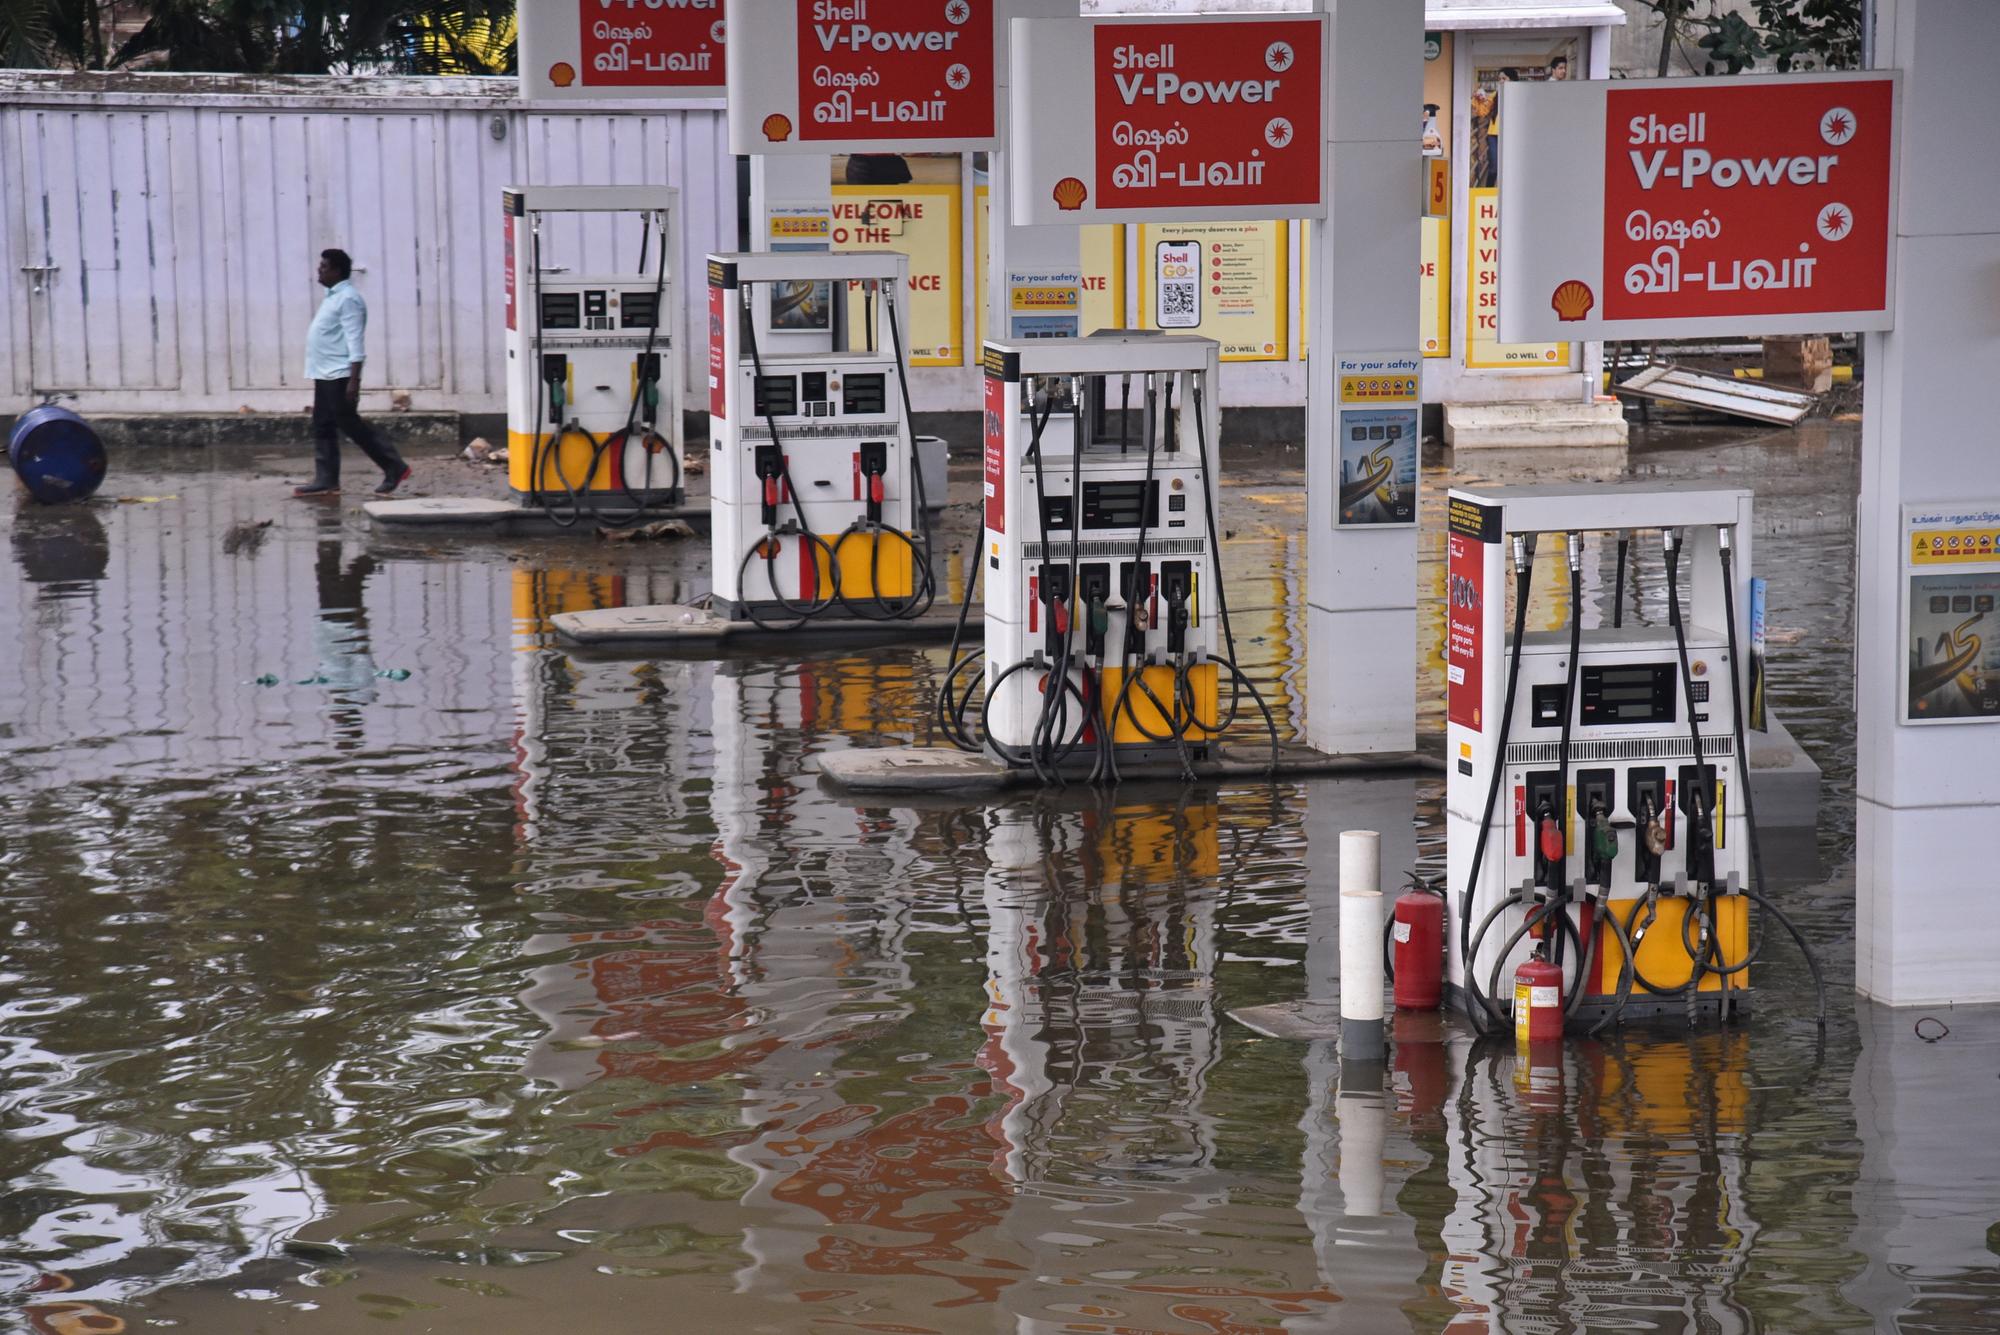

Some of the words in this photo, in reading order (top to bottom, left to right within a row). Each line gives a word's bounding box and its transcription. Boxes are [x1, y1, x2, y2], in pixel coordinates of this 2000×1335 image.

[813, 0, 866, 21] Shell
[593, 20, 653, 45] ஷெல்
[814, 24, 960, 52] V-Power
[593, 43, 712, 72] வி-பவர்
[1112, 44, 1174, 69] Shell
[812, 65, 880, 91] ஷெல்
[1113, 73, 1281, 105] V-Power
[812, 90, 947, 123] வி-பவர்
[1112, 121, 1189, 152] ஷெல்
[1628, 112, 1706, 145] Shell
[1112, 149, 1266, 189] வி-பவர்
[1629, 148, 1839, 190] V-Power
[1434, 171, 1444, 203] 5
[854, 227, 891, 243] THE
[1162, 227, 1180, 235] Every
[1181, 226, 1206, 235] journey
[1244, 225, 1258, 234] plus
[1625, 208, 1721, 248] ஷெல்
[1163, 252, 1188, 263] Shell
[1624, 243, 1818, 295] வி-பவர்
[1028, 275, 1048, 283] your
[1051, 273, 1078, 282] safety
[912, 348, 931, 356] WELL
[1224, 345, 1237, 353] GO
[1238, 345, 1257, 353] WELL
[1505, 352, 1518, 360] GO
[1520, 352, 1538, 360] WELL
[1341, 361, 1357, 370] For
[1360, 362, 1384, 372] your
[1387, 360, 1418, 371] safety
